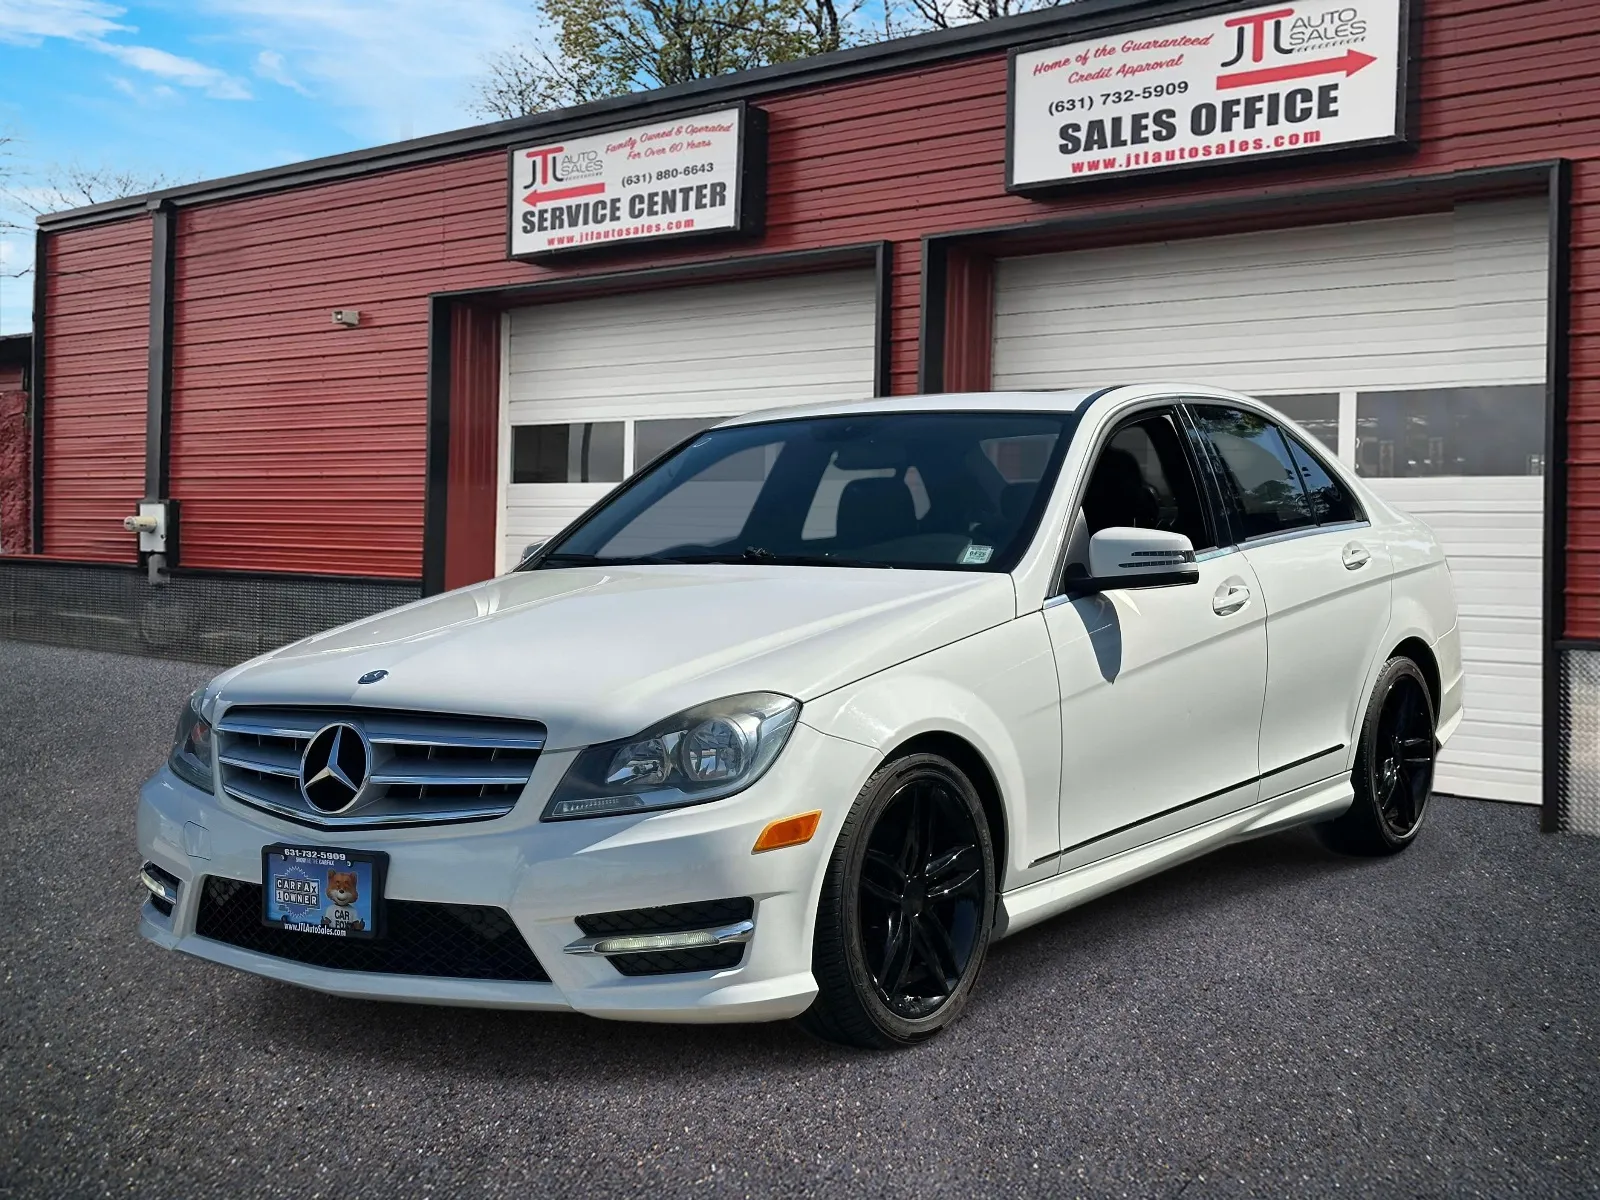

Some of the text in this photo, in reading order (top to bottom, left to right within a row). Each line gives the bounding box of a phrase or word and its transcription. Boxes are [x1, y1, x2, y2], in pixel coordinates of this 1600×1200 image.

[1289, 20, 1367, 46] SALES
[1290, 8, 1357, 32] AUTO
[1220, 8, 1295, 68] JTL
[1033, 32, 1215, 76] Home of the Guaranteed
[1068, 54, 1184, 84] Credit Approval
[1048, 81, 1189, 116] (631) 732-5909
[1058, 83, 1339, 155] SALES OFFICE
[605, 122, 733, 155] Family Owned & Operated
[627, 138, 712, 161] For Over 60 Years
[561, 150, 597, 165] AUTO
[1071, 130, 1321, 174] www.jtlautosales.com
[523, 146, 565, 190] JTL
[561, 159, 603, 177] SALES
[621, 173, 653, 188] (631)
[656, 162, 714, 181] 880-6643
[521, 181, 727, 235] SERVICE CENTER
[547, 217, 695, 247] www.jtlautosales.com
[284, 848, 346, 861] 631-732-5909
[277, 879, 317, 893] CARFAX
[284, 892, 317, 905] OWNER
[334, 909, 350, 920] CAR
[284, 922, 347, 937] www.JTLAutoSales.com
